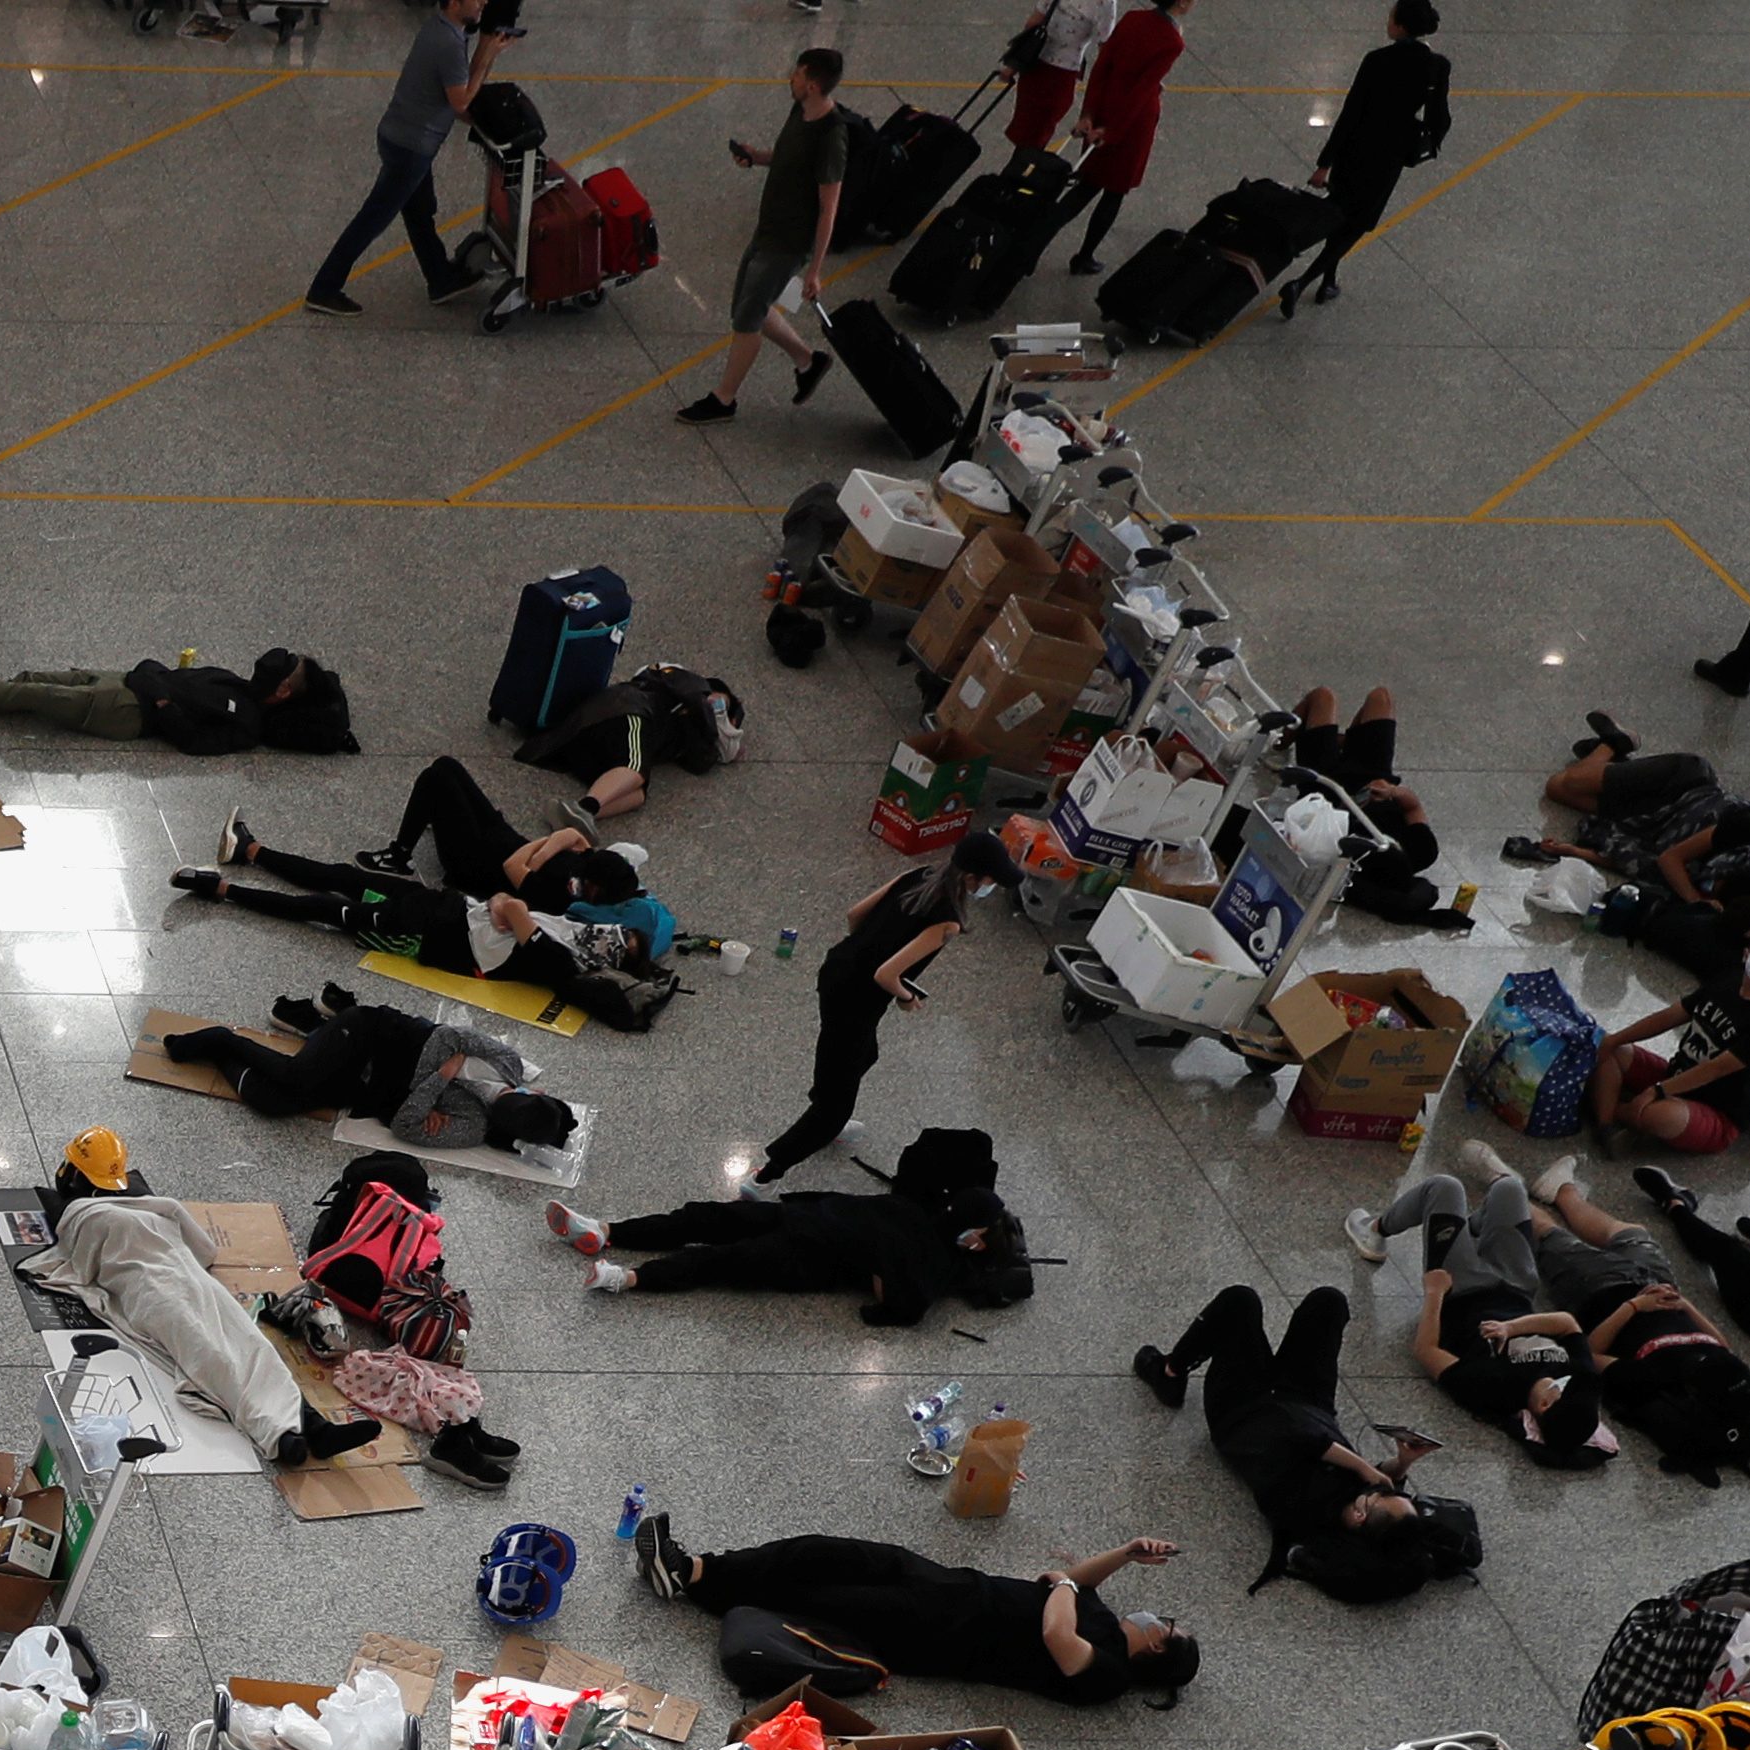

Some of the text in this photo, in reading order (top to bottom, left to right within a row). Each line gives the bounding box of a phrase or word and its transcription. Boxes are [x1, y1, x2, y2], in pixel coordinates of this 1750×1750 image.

[879, 805, 912, 832] TSINGTAO
[918, 816, 966, 838] TSINGTAO
[1089, 833, 1112, 847] BLUE
[1233, 881, 1253, 899] TOTO
[1228, 893, 1260, 924] WASHLET
[1322, 1114, 1358, 1132] vita
